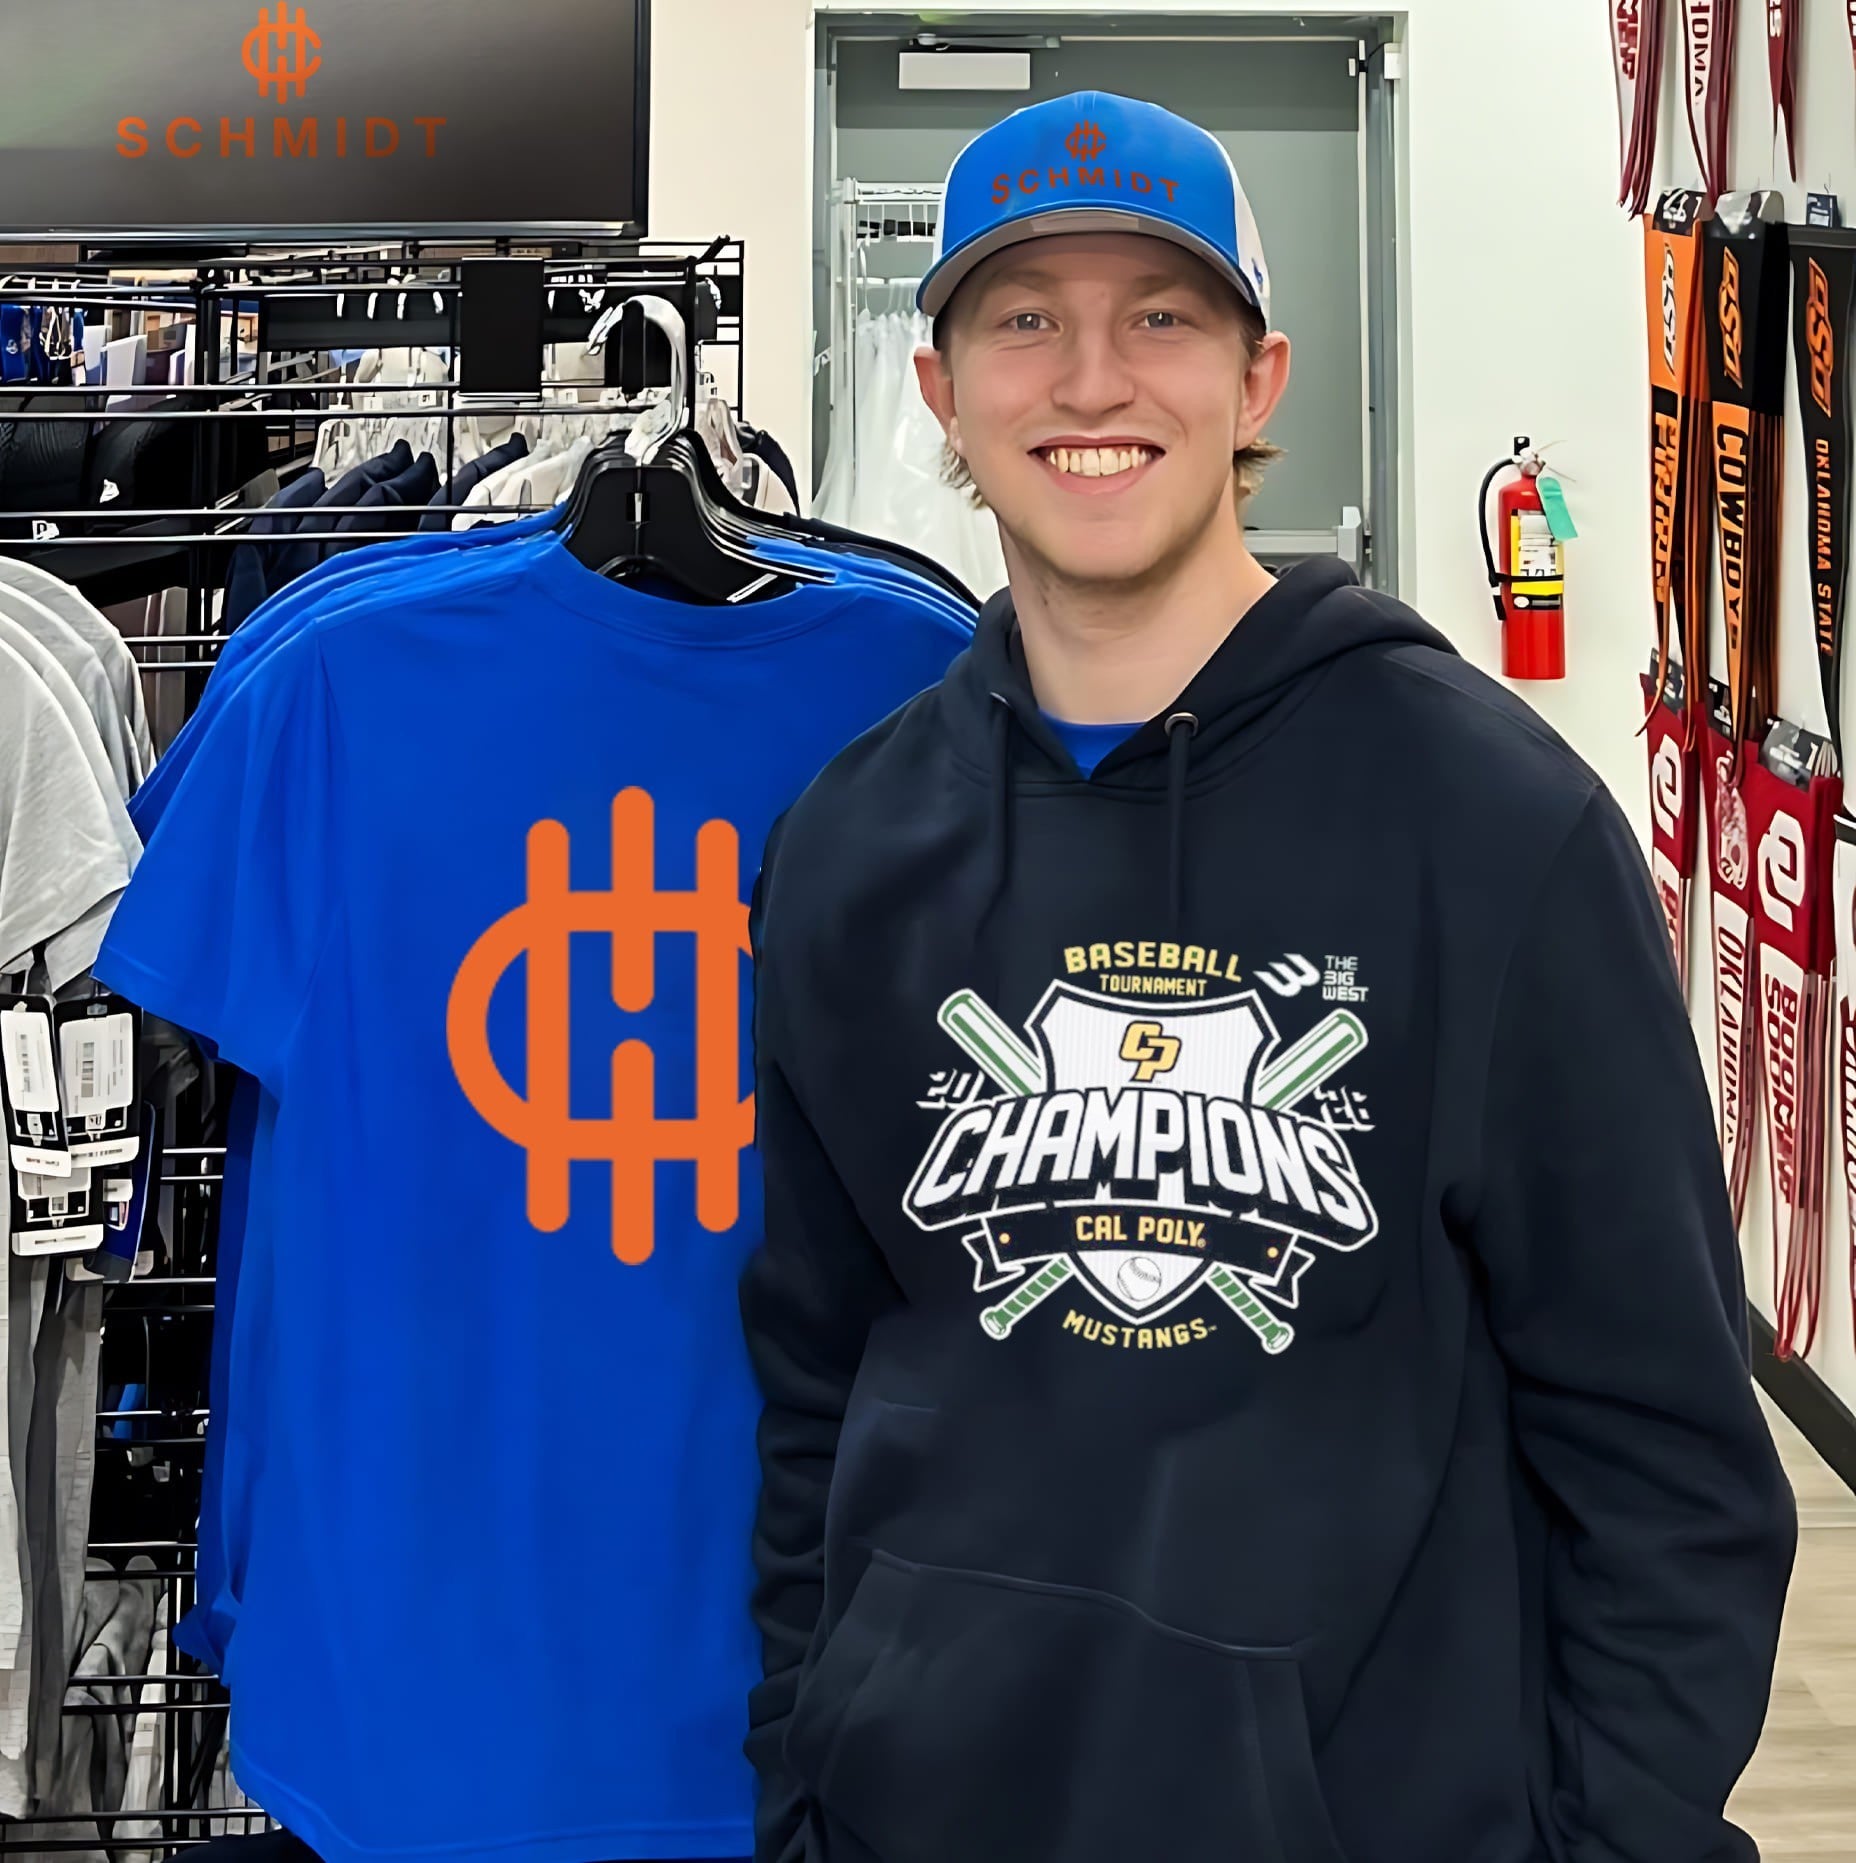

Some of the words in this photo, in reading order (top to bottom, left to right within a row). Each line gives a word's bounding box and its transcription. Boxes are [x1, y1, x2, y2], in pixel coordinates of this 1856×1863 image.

[115, 116, 448, 159] SCHMIDT
[991, 166, 1179, 205] SCHMIDT
[1815, 438, 1832, 571] OKLAHOMA
[1063, 941, 1242, 983] BASEBALL
[1323, 970, 1355, 986] BIG
[1324, 954, 1359, 971] THE
[1099, 974, 1207, 997] TOURNAMENT
[1322, 985, 1369, 1002] WEST
[905, 1086, 1376, 1238] CHAMPIONS
[1075, 1215, 1127, 1241] CAL
[1062, 1308, 1209, 1350] MUSTANGS
